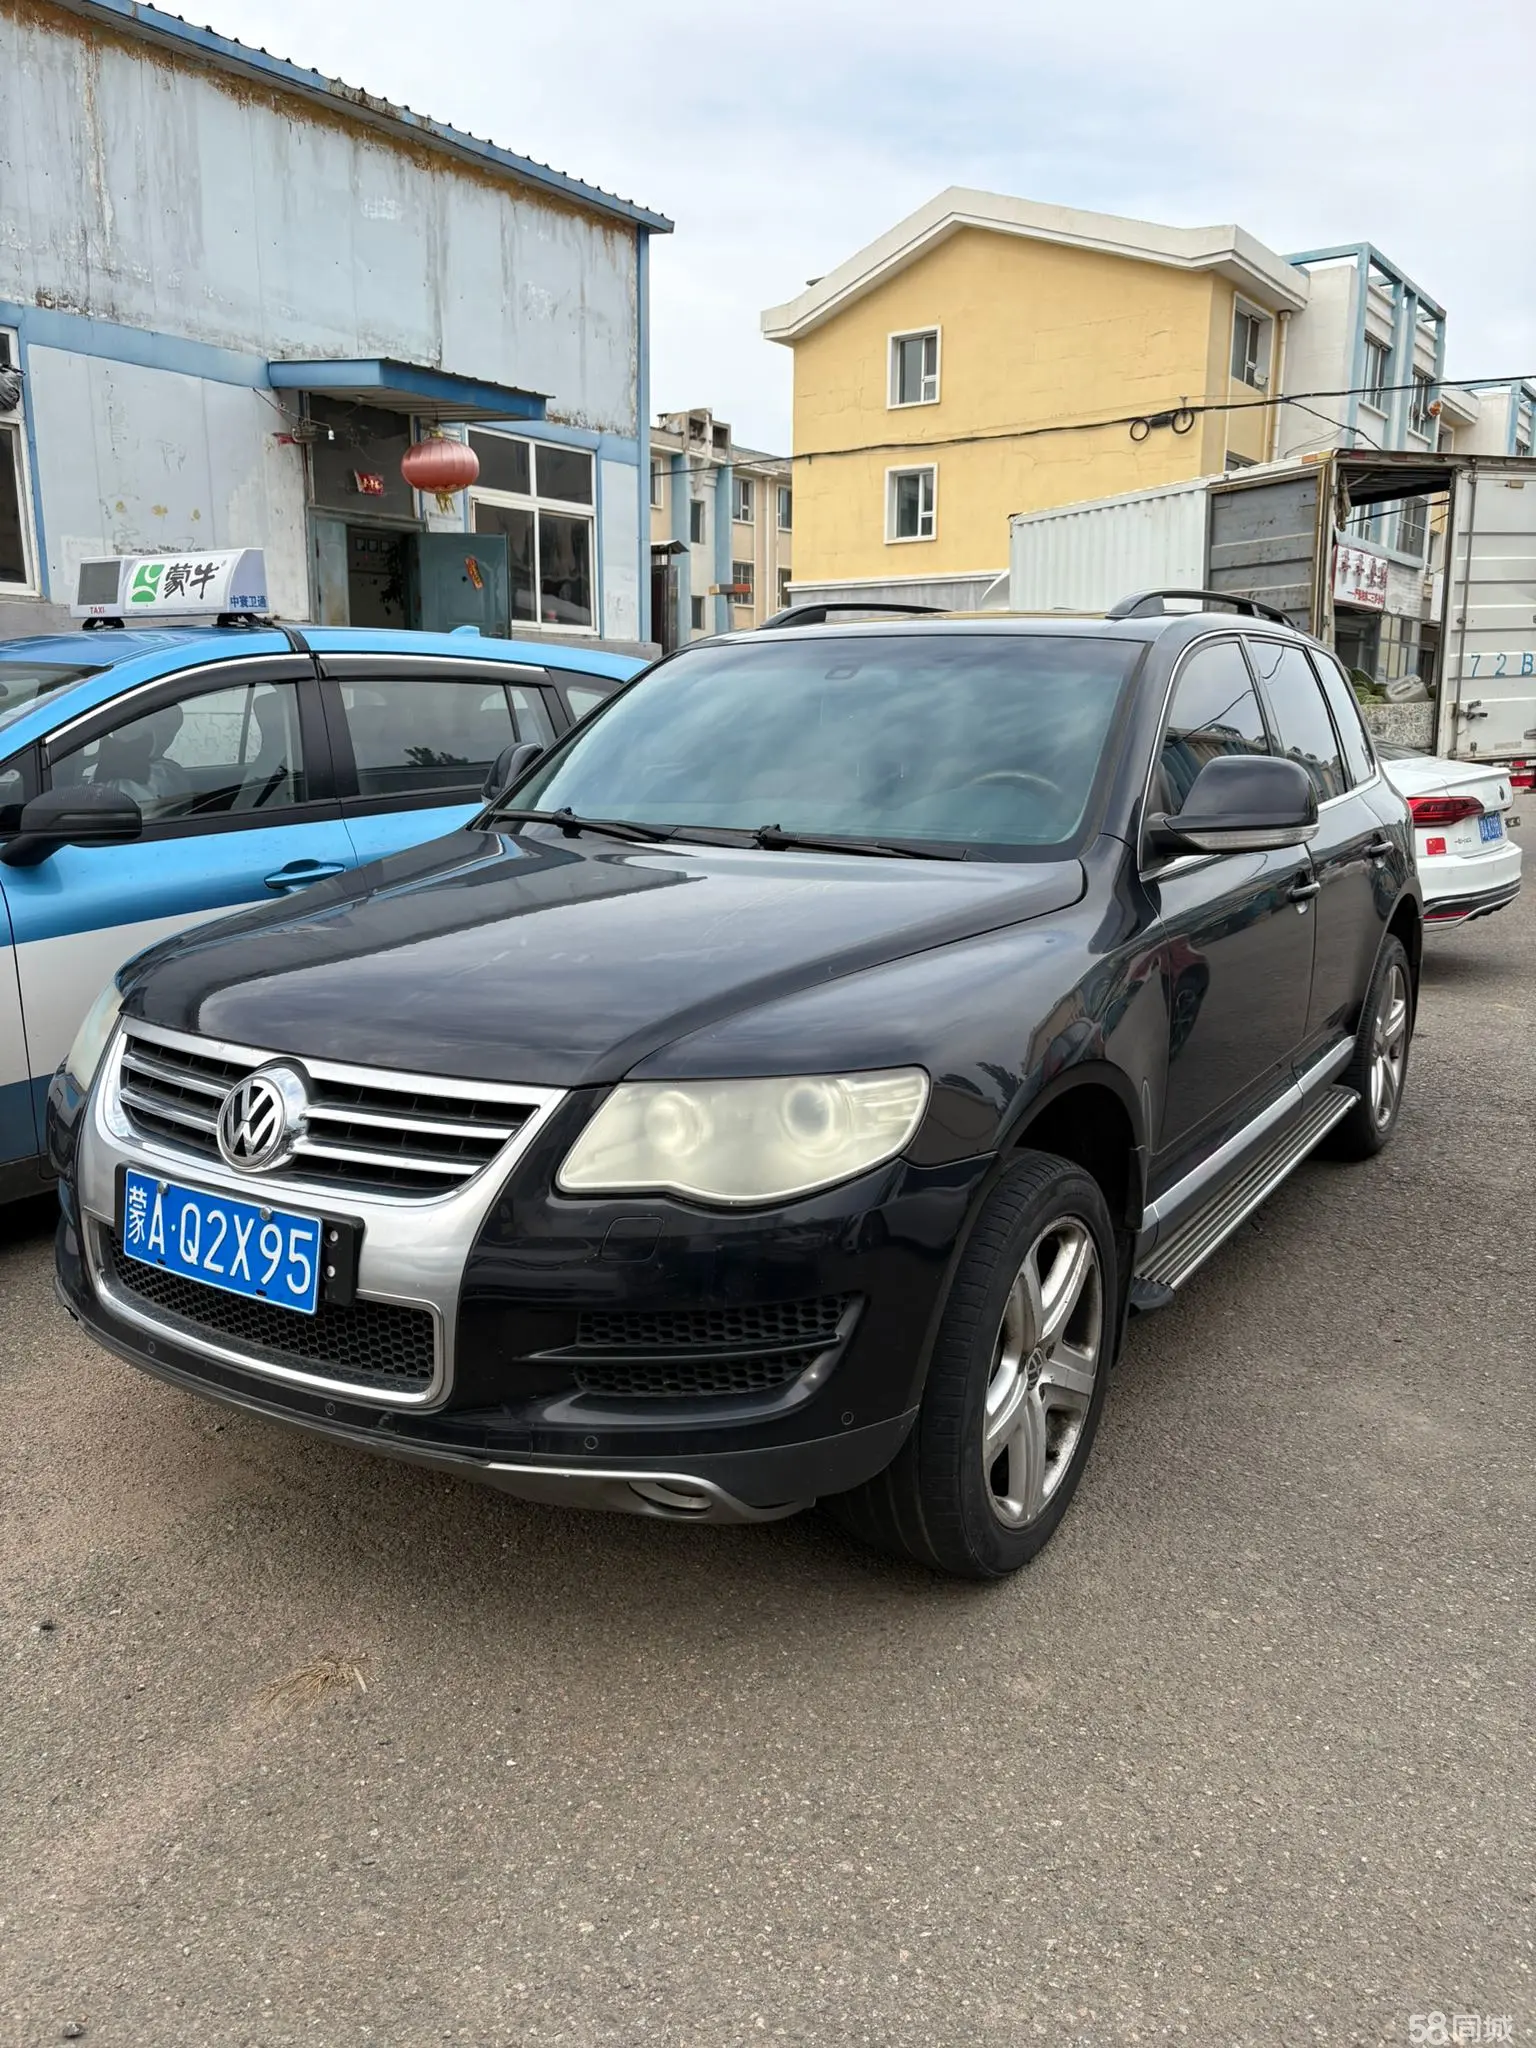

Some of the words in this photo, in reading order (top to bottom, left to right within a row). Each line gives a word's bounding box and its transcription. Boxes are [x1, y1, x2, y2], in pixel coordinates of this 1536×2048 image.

[164, 562, 219, 600] 蒙牛
[90, 606, 104, 614] TAXI
[128, 1186, 313, 1294] 蒙A·Q2X95
